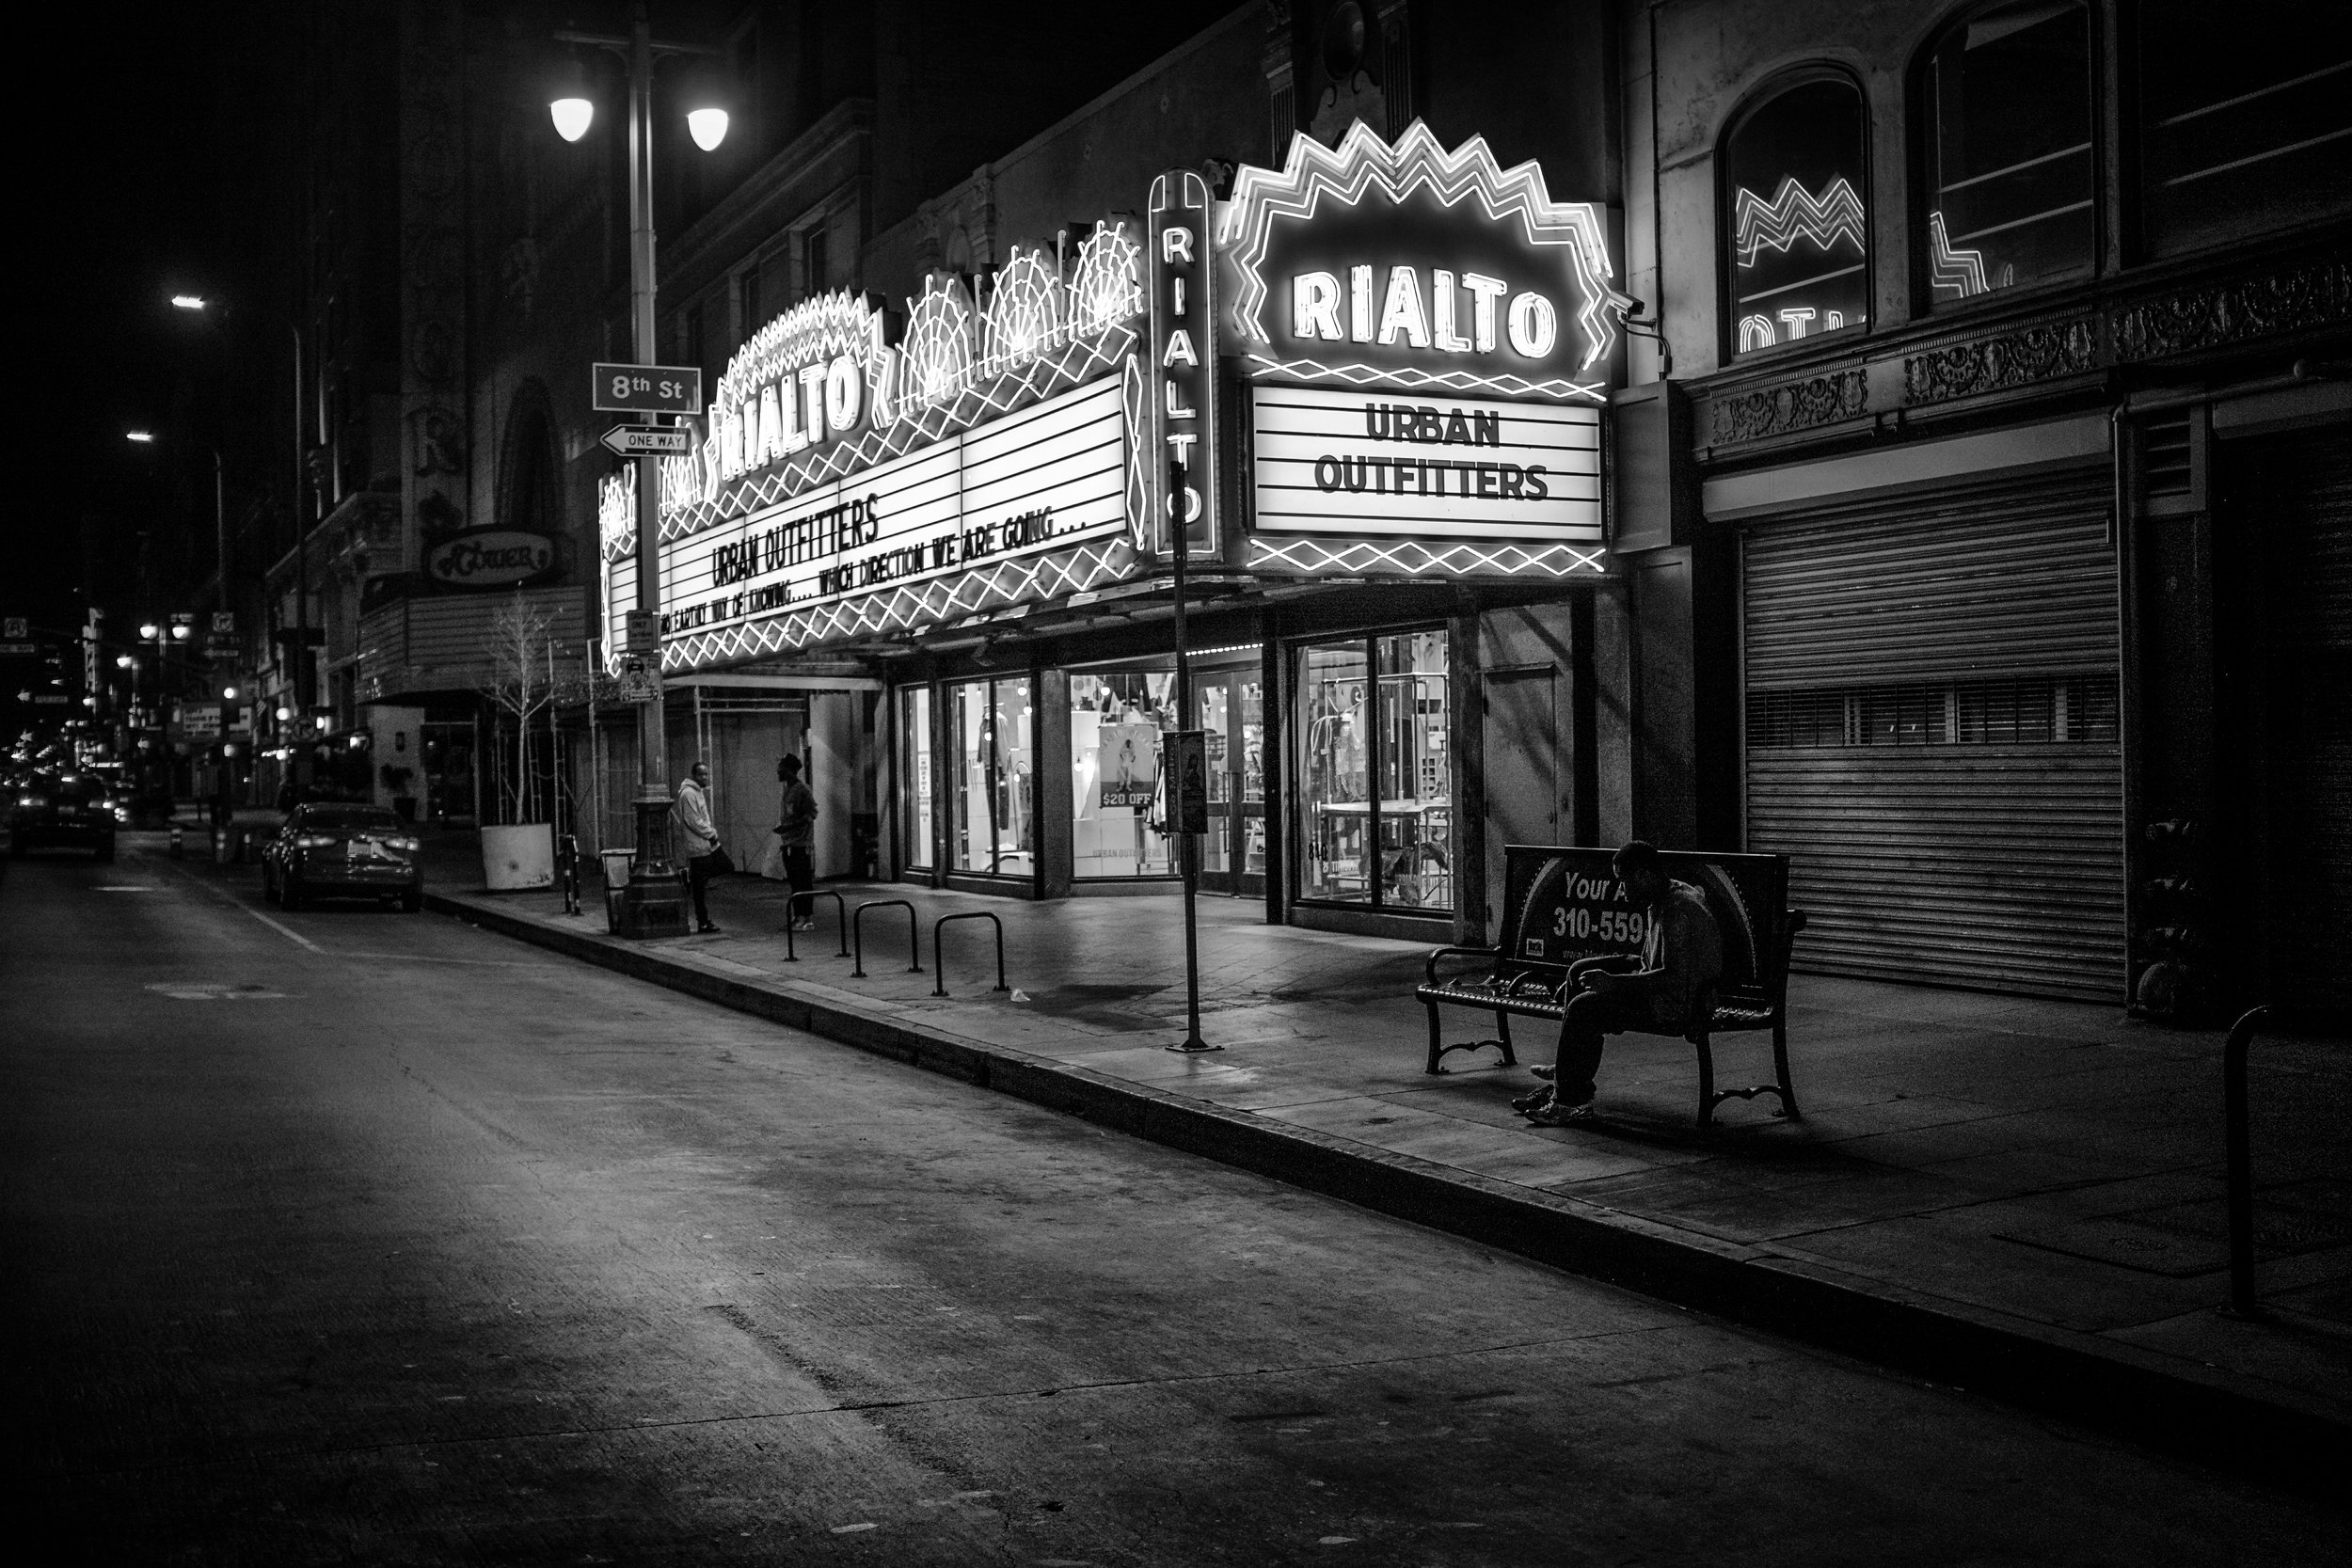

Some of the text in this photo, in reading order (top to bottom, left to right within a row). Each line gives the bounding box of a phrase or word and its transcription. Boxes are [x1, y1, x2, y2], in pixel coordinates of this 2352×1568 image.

[1293, 264, 1558, 359] RIALTO
[612, 375, 683, 399] 8th St
[1163, 226, 1202, 524] RIALTO
[628, 435, 682, 447] ONE WAY
[721, 355, 861, 483] RIALTO
[1366, 403, 1501, 449] URBAN
[1314, 454, 1549, 502] OUTFITTERS
[712, 493, 879, 587] URBAN OUTFITTERS
[711, 596, 728, 623] WAY
[733, 592, 743, 619] OF
[819, 562, 853, 597] WHICH
[860, 543, 924, 588] DIRECTION
[932, 533, 957, 569] WE
[961, 522, 997, 563] ARE
[1103, 792, 1152, 806] $20 OFF
[1565, 871, 1611, 901] Your
